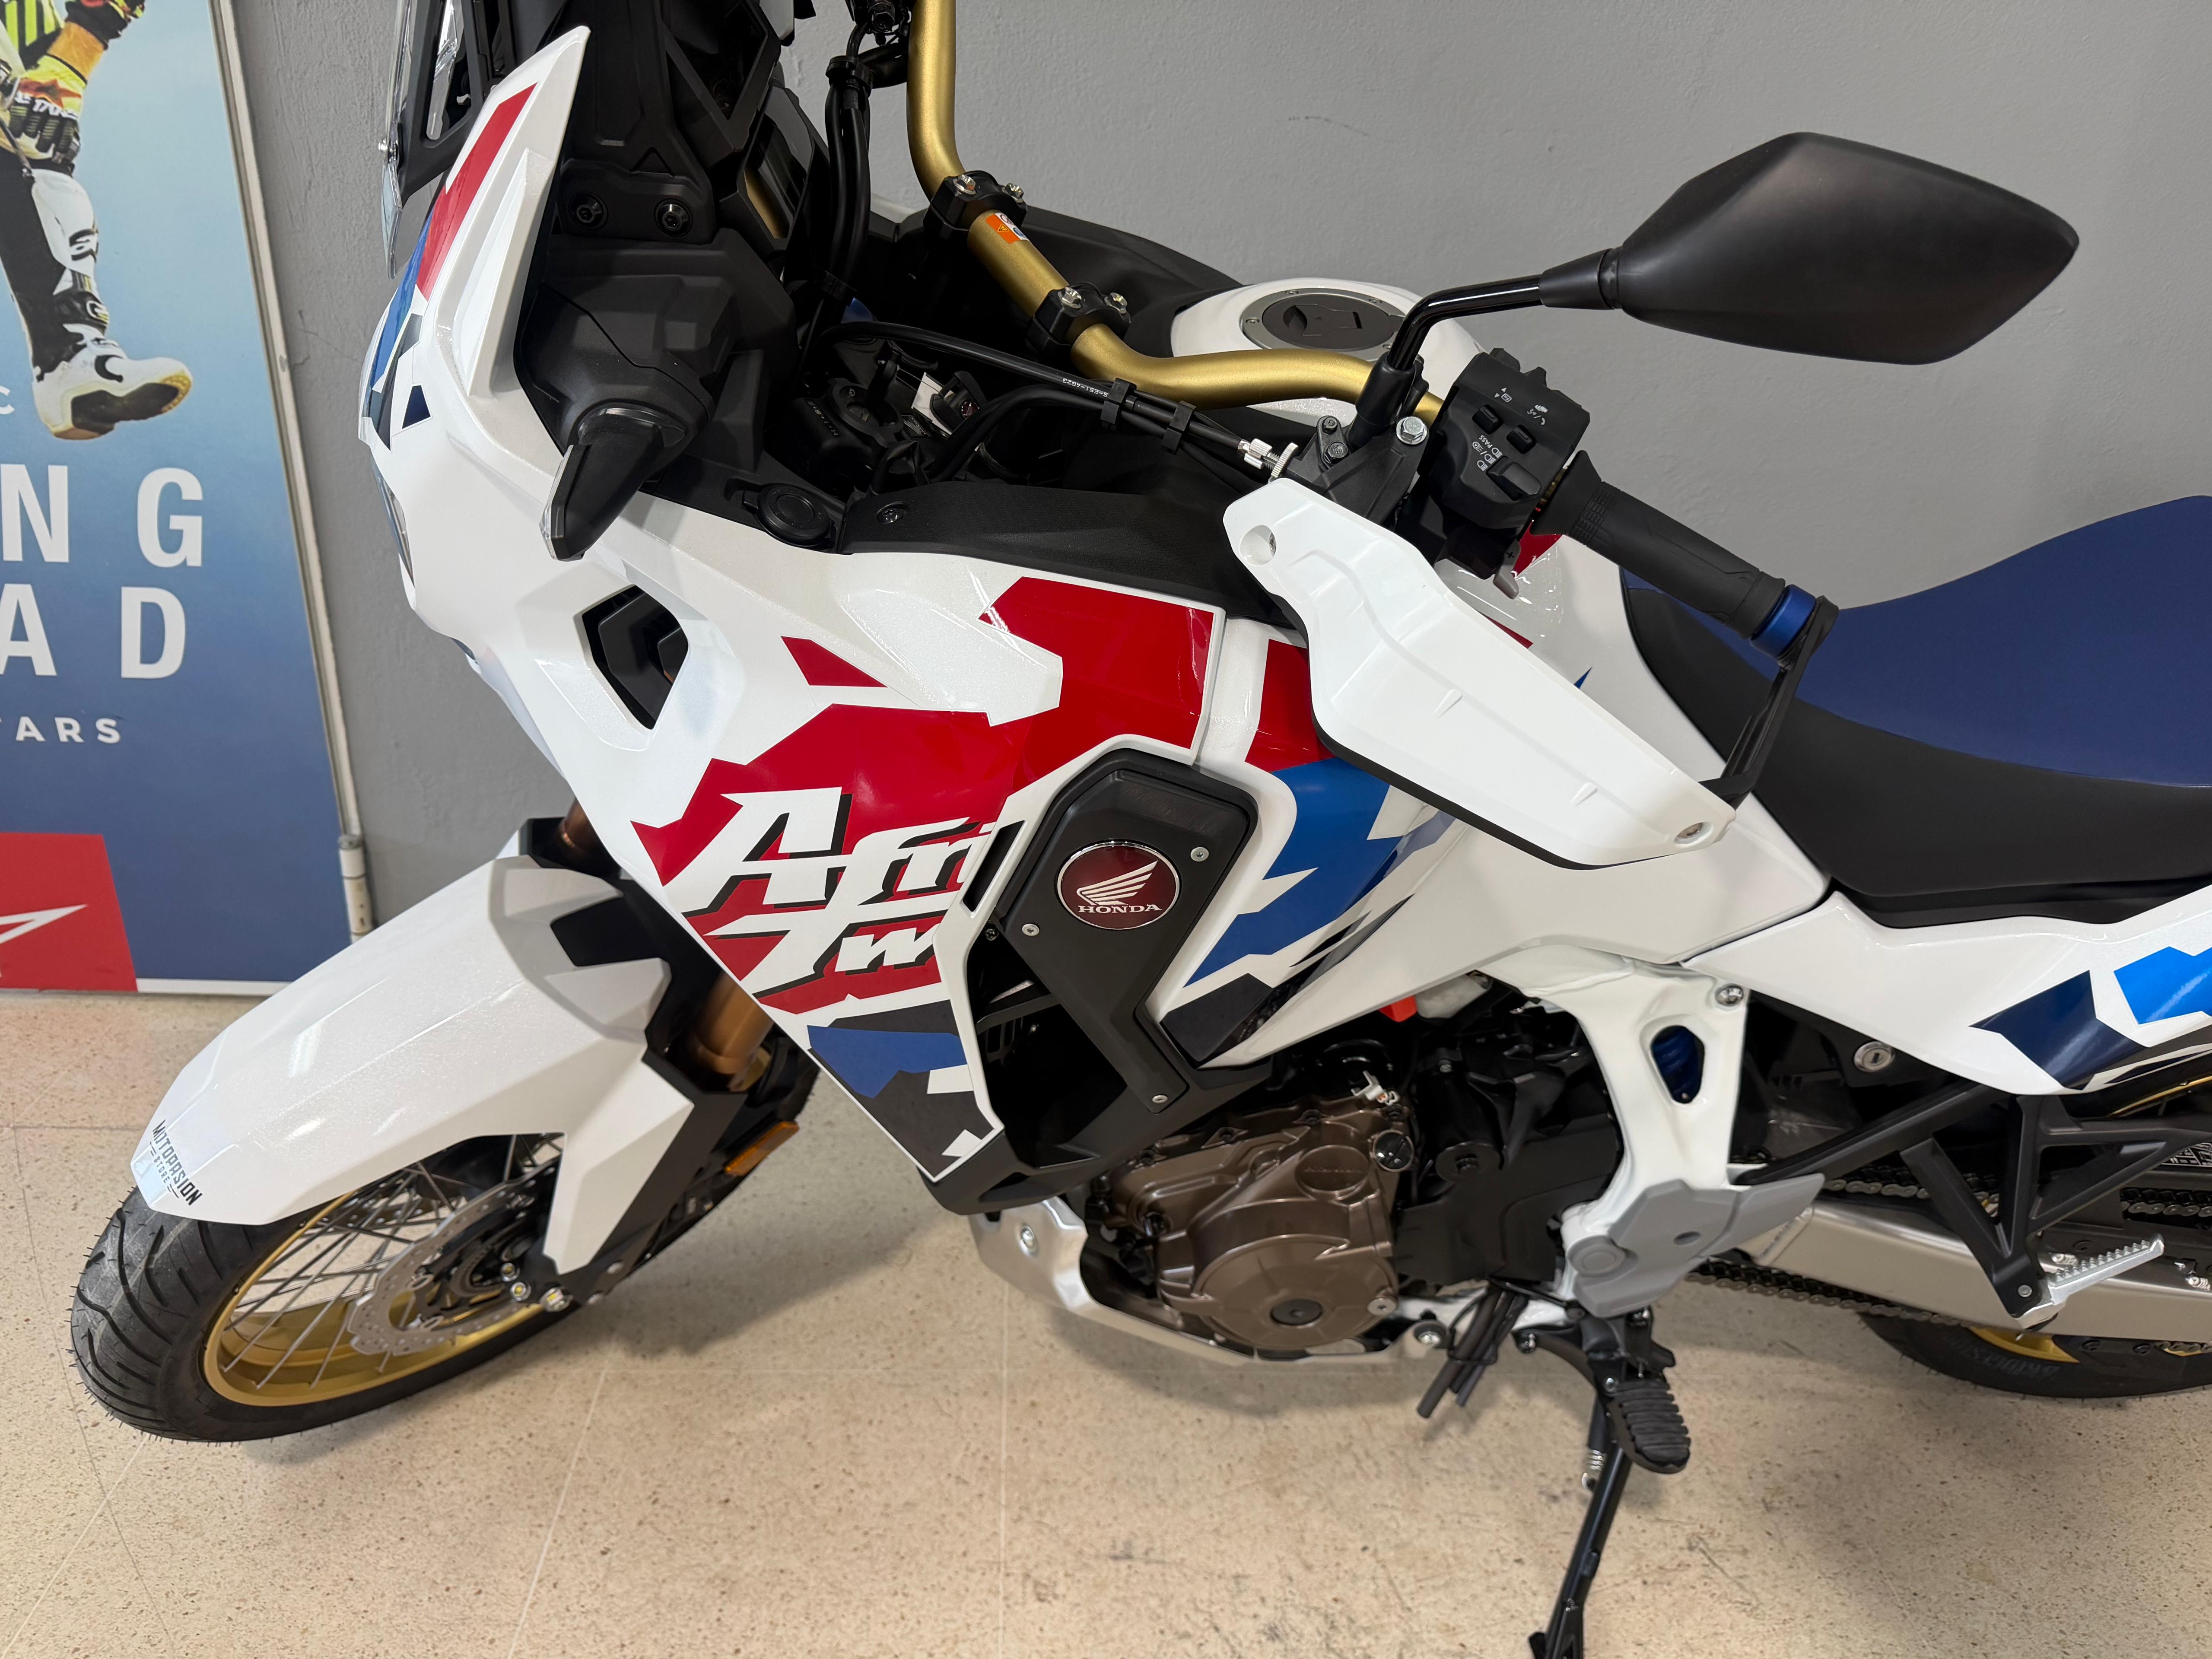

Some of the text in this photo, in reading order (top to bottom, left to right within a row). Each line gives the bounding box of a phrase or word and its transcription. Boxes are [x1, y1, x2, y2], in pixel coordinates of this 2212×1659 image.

[1479, 435, 1493, 448] PASS
[0, 716, 121, 744] ARS
[1078, 904, 1162, 913] HONDA
[152, 1119, 203, 1206] MOTOPASION
[154, 1156, 170, 1183] STORE
